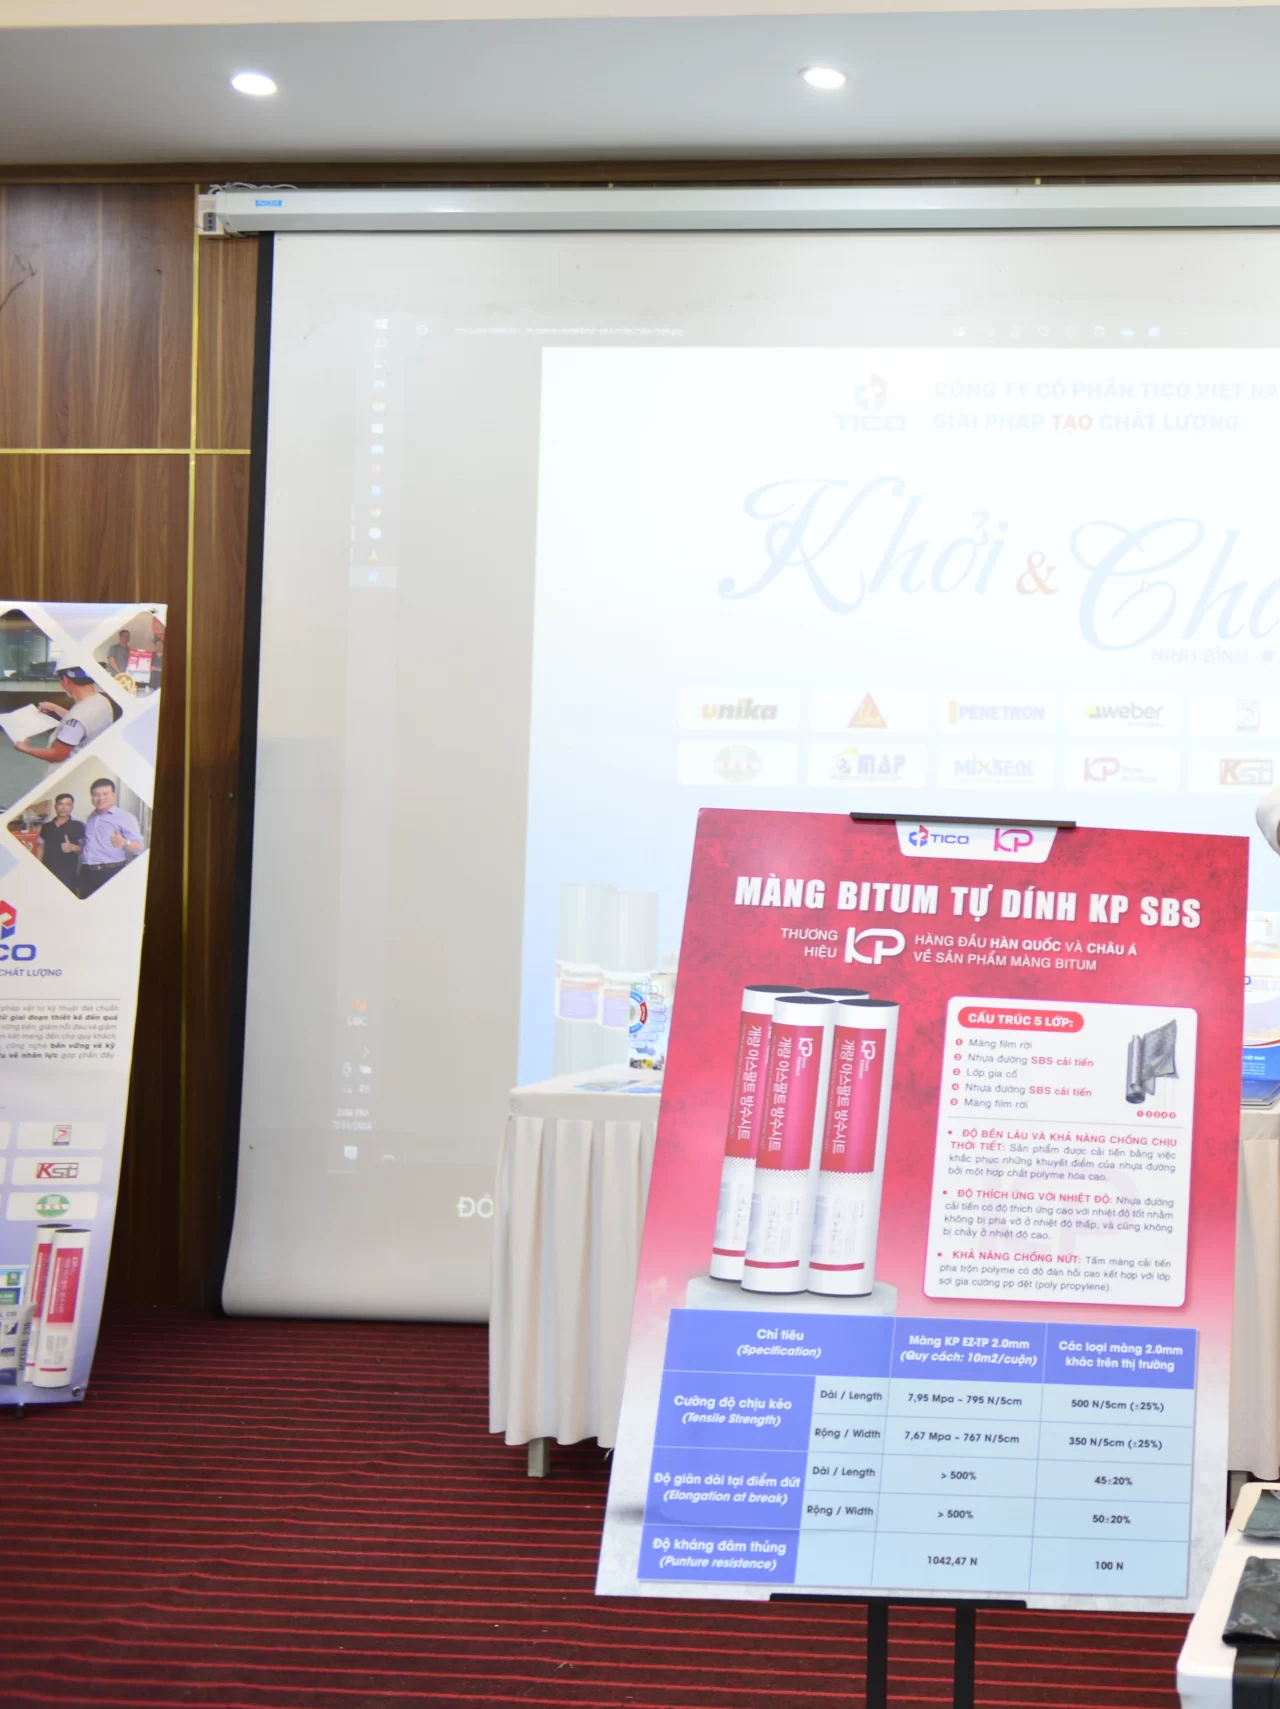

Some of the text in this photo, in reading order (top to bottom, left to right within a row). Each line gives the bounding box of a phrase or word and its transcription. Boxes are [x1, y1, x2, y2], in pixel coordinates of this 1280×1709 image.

[1004, 382, 1029, 398] TY
[1140, 382, 1191, 398] TICO
[832, 413, 907, 431] TICO
[1051, 413, 1094, 435] TẠO
[717, 476, 1009, 614] Khởi
[1014, 550, 1060, 597] &
[702, 699, 779, 720] unika
[959, 704, 1046, 721] PENETRON
[1101, 701, 1165, 720] weber
[930, 833, 970, 845] TICO
[734, 872, 1200, 928] MÀNG BITUM TỰ DÍNH KP SBS
[780, 927, 838, 941] THƯƠNG
[804, 944, 837, 958] HIỆU
[843, 926, 906, 965] KP
[914, 932, 1137, 955] HÀNG ĐẦU HÀN QUỐC VÀ CHÂU Á
[913, 948, 1097, 970] VỀ SẢN PHẨM MÀNG BITUM
[967, 1011, 1073, 1028] CẤU TRÚC 5 LỚP:
[968, 1038, 997, 1050] Màng
[999, 1039, 1017, 1048] film
[967, 1053, 1094, 1067] Nhựa đường SBS cải tiến
[966, 1068, 1018, 1080] Lớp gia cố
[962, 1127, 1177, 1147] ĐỘ BỀN LÂU VÀ KHẢ NĂNG CHỐNG CHỊU
[756, 1328, 804, 1341] Chỉ tiêu
[909, 1335, 1030, 1349] Màng KP EZ-TP 2.0mm
[736, 1344, 822, 1359] (Specification)
[1058, 1340, 1183, 1356] Các loại màng 2.0mm
[899, 1350, 1038, 1367] (Quy cách: 10m2/cuộn)
[1065, 1356, 1175, 1373] khác trên thị trường
[673, 1395, 792, 1411] Cường độ chịu kéo
[908, 1393, 929, 1403] 7,95
[931, 1394, 955, 1404] Mpa
[966, 1395, 985, 1404] 795
[987, 1396, 1022, 1406] N/5cm
[1071, 1399, 1164, 1413] 500 N/5cm (±25%)
[681, 1411, 781, 1428] (Tensile Strength)
[663, 1489, 788, 1506] (Elongation at break)
[652, 1537, 787, 1556] Độ kháng đâm thủng
[659, 1555, 777, 1571] (Punture resistence)
[927, 1555, 978, 1566] 1042,47 N
[1095, 1561, 1124, 1570] 100 N
